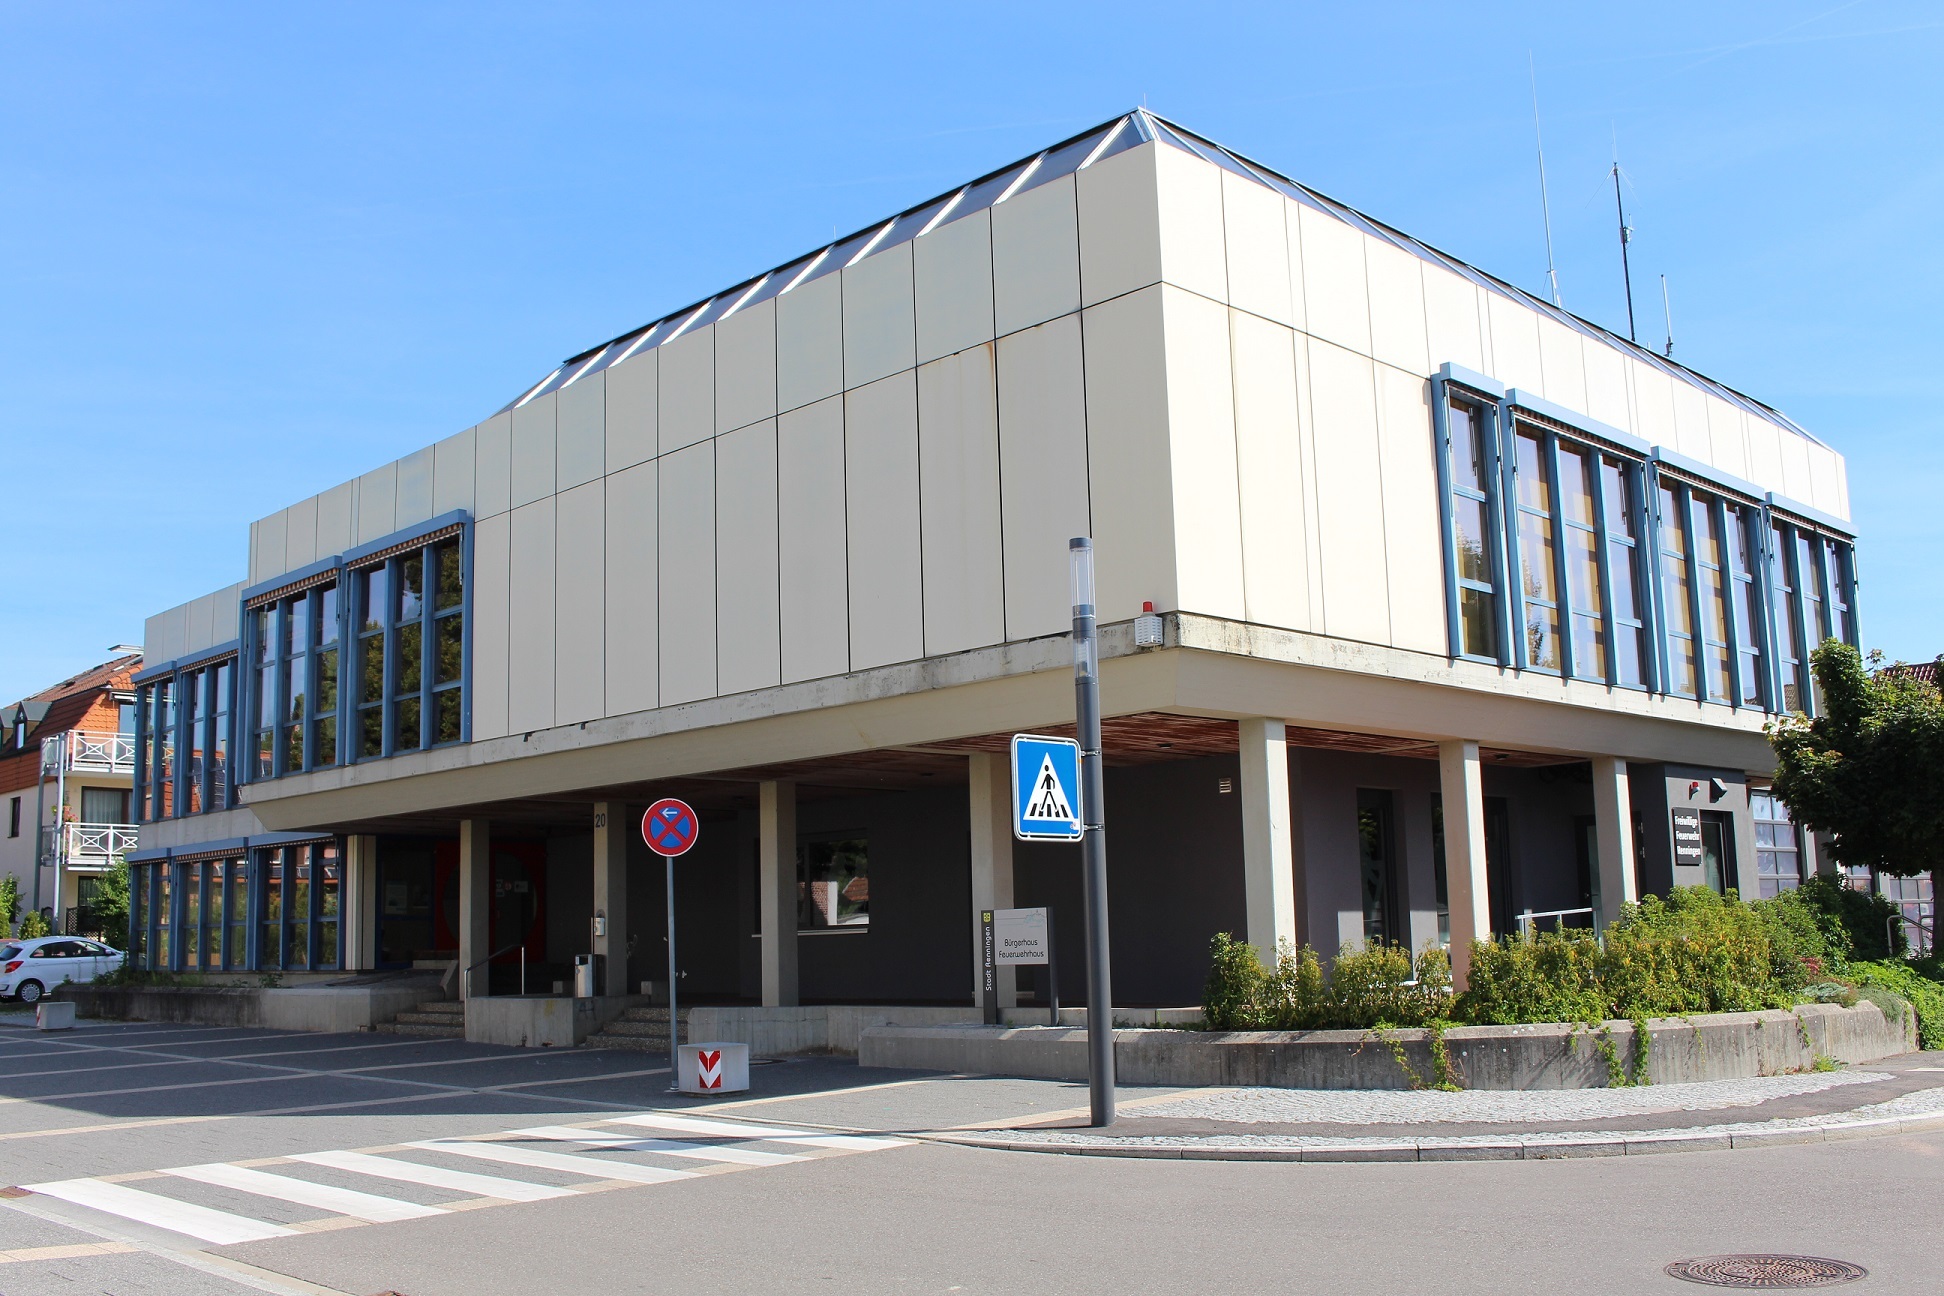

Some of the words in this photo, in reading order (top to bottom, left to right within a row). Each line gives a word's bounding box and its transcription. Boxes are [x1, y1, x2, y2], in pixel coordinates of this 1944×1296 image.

[595, 813, 606, 828] 20
[1675, 830, 1700, 841] Feuerwehr
[1676, 845, 1701, 858] Renningen
[1004, 938, 1038, 948] Bürgerhaus
[998, 950, 1044, 958] Feuerwehrhaus
